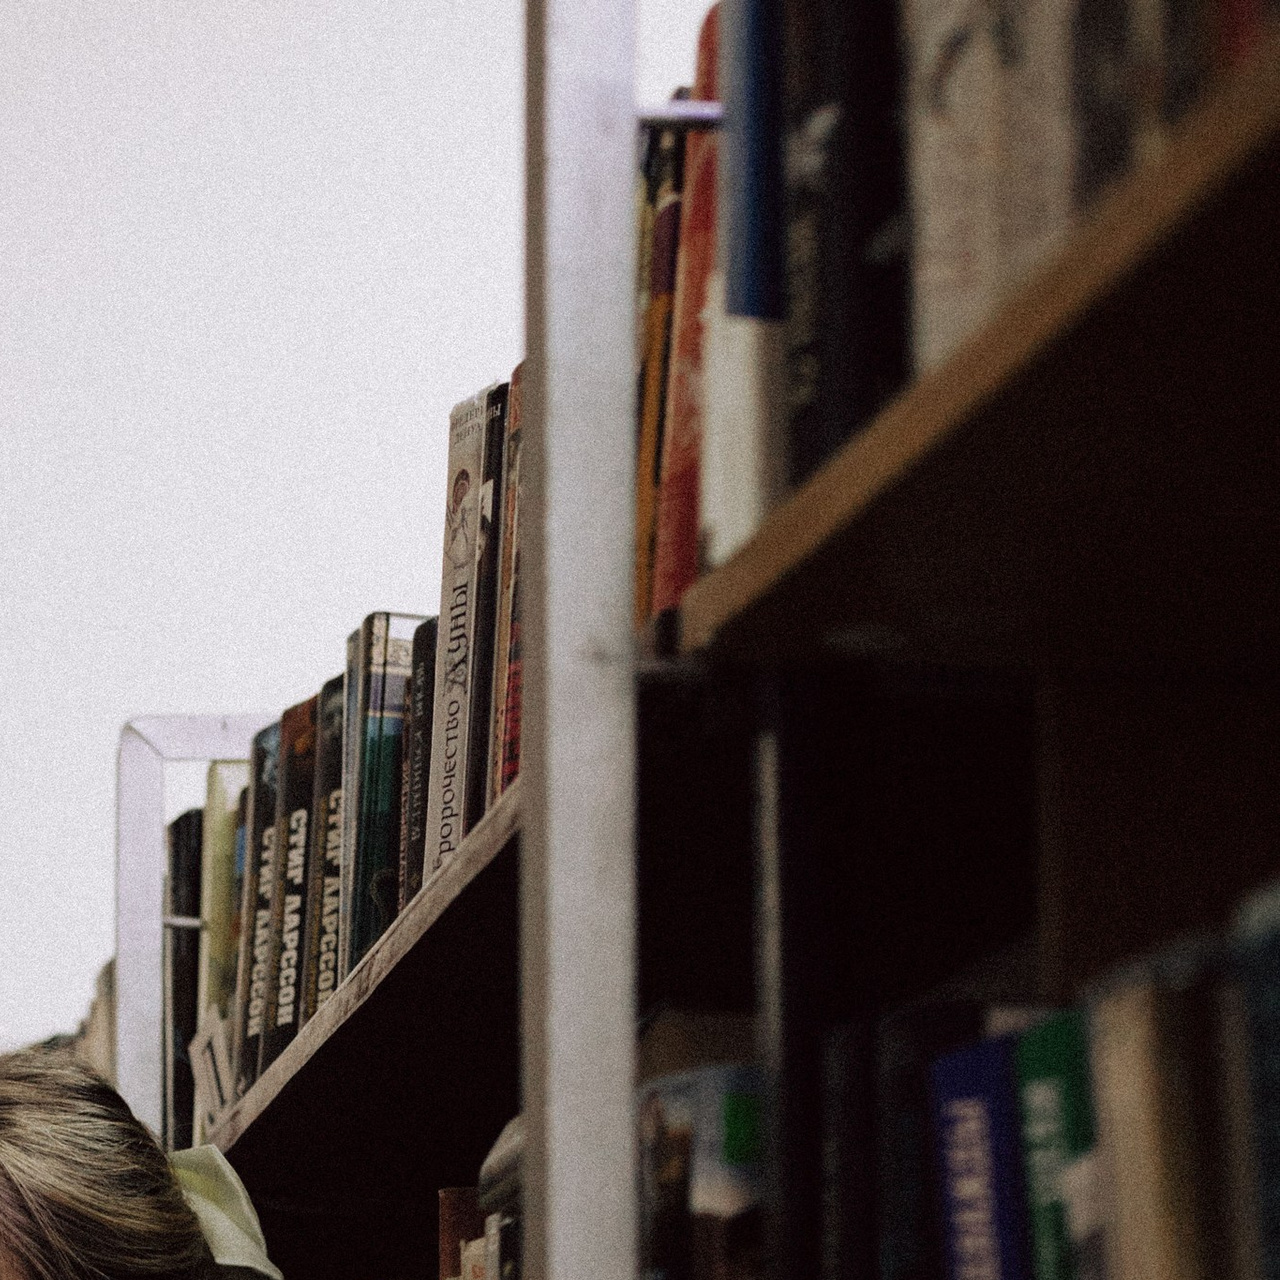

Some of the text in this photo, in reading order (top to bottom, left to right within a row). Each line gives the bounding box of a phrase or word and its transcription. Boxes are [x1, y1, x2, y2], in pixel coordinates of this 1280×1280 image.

[327, 789, 342, 869] СТИГ
[434, 699, 460, 870] ророчество
[247, 827, 275, 1037] СТИГ ЛАРССОН
[277, 810, 308, 1027] СТИГ ЛАРССОН
